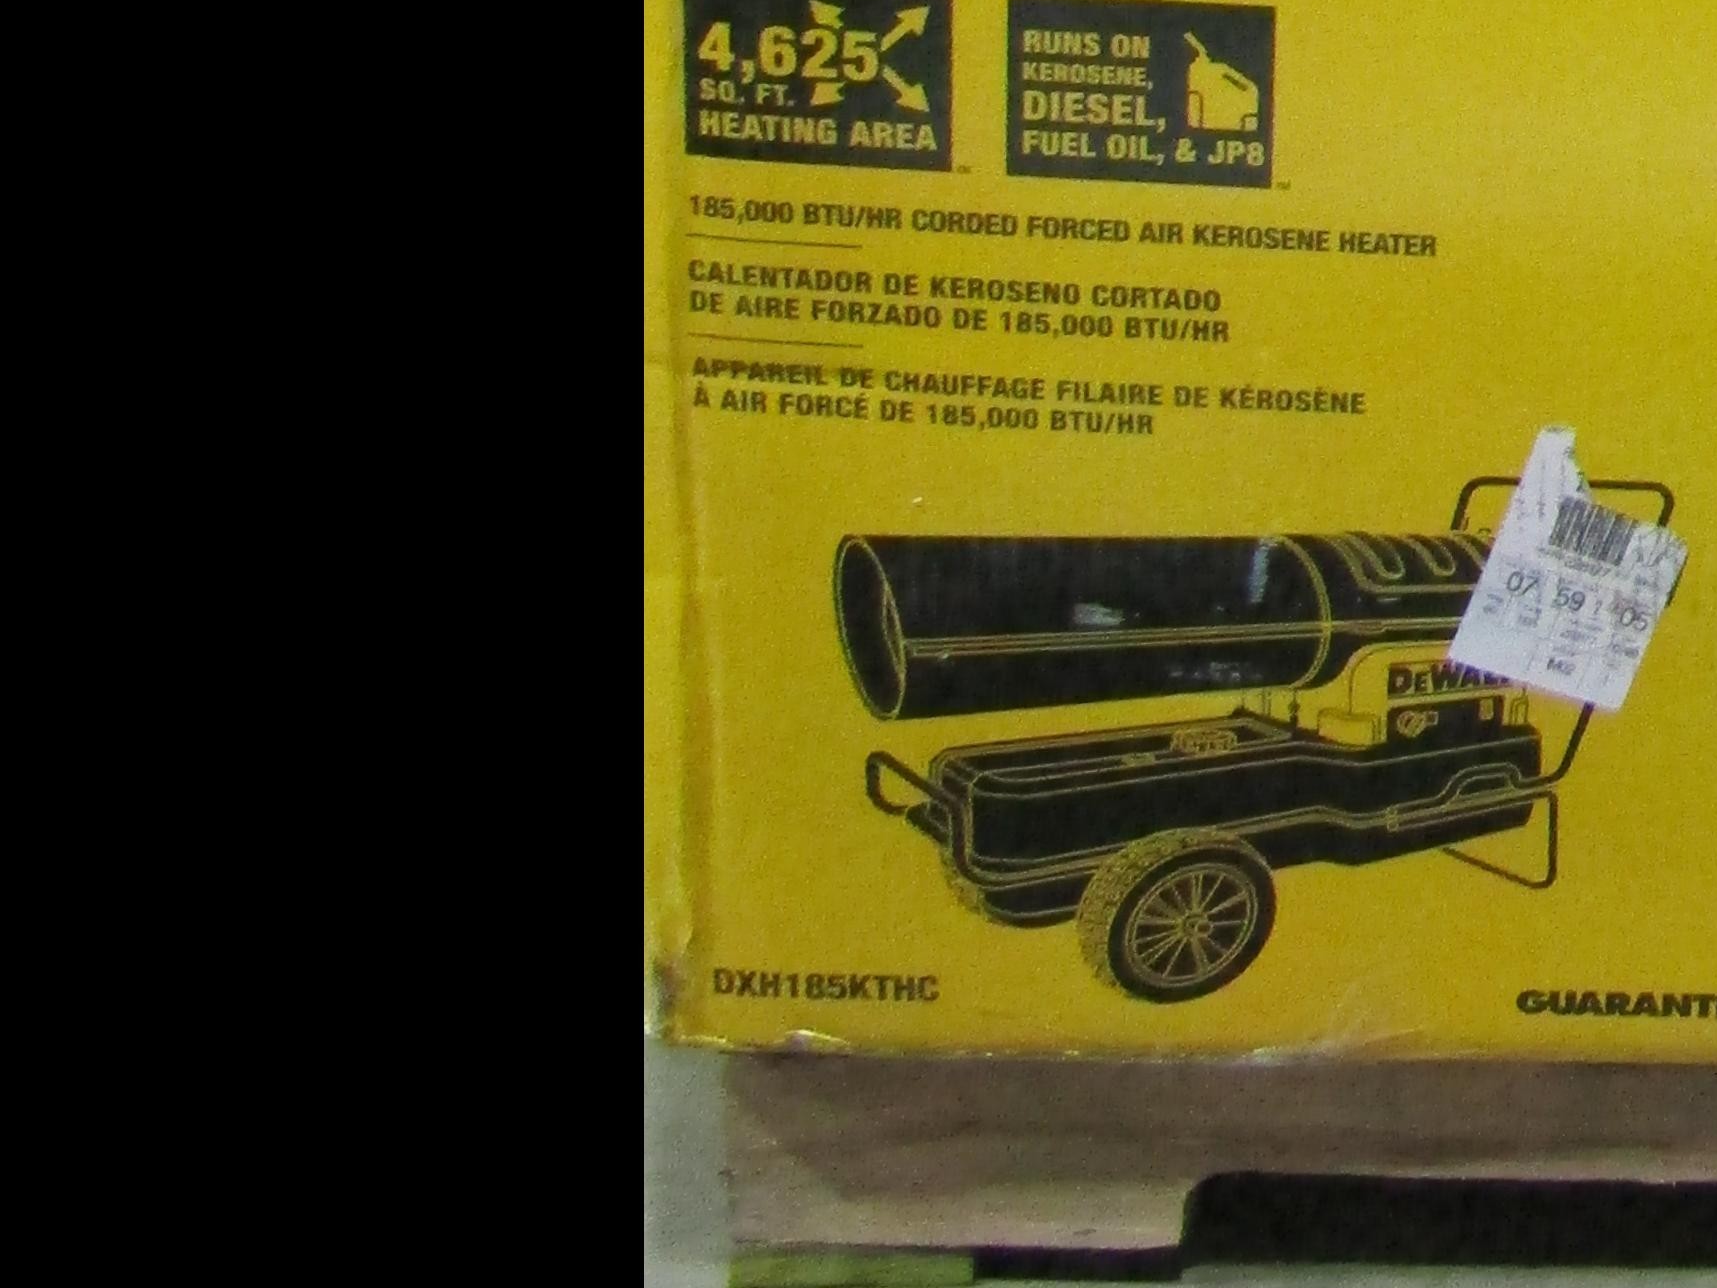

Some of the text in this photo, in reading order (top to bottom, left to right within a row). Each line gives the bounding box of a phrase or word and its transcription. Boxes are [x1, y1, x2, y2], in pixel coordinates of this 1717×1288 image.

[699, 20, 879, 84] 4,625
[1022, 30, 1151, 59] RUNS ON
[700, 77, 795, 108] SQ. FT.
[1022, 61, 1154, 91] KEROSENE,
[700, 112, 938, 152] HEATING AREA
[1022, 92, 1166, 133] DIESEL,
[1022, 130, 1266, 167] FUEL OIL, & JP8
[690, 193, 1437, 258] 185,000 BTU/HR CORDED FORCED AIR KEROSENE HEATER
[687, 258, 1222, 313] CALENTADOR DE KEROSENO CORTADO
[690, 289, 1230, 344] DE AIRE FORZADO DE 185,000 BTU/HR
[692, 356, 828, 387] APPAREIL
[840, 365, 875, 391] DE
[884, 370, 1045, 403] CHAUFFAGE
[1055, 379, 1164, 408] FILAIRE
[1173, 384, 1209, 410] DE
[721, 387, 768, 414] AIR
[778, 390, 869, 422] FORCÉ
[879, 397, 914, 424] DE
[926, 401, 1040, 433] 185,000
[1049, 407, 1155, 436] BTU/HR
[712, 966, 940, 1005] DXH185KTHC
